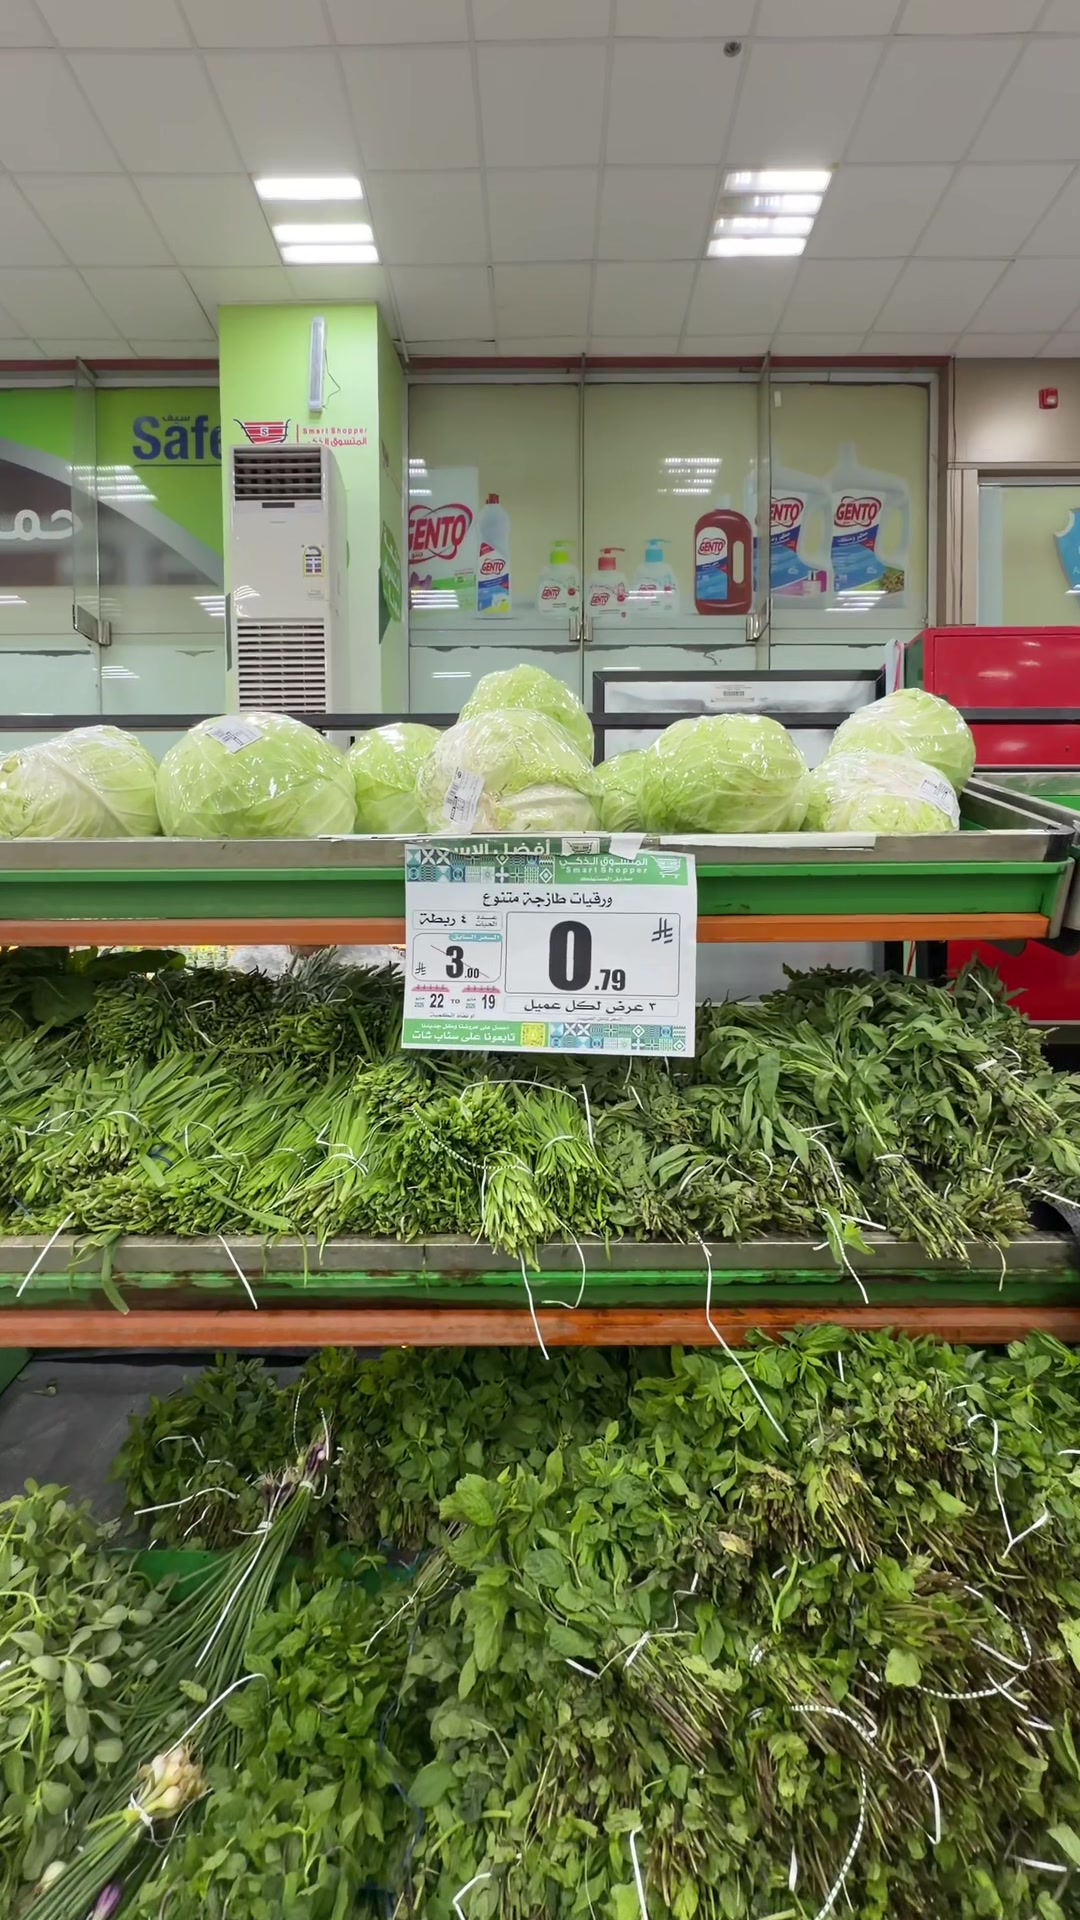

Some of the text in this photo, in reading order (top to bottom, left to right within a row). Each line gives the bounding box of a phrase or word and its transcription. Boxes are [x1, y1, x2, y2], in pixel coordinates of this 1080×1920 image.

[302, 426, 368, 436] Smart Shopper
[836, 503, 878, 521] GENTO
[700, 541, 724, 552] GENTO
[481, 562, 504, 572] GENTO
[559, 856, 598, 867] الذكي
[566, 866, 648, 875] Smart Shopper
[482, 891, 613, 907] ورقيات طازجة متنوع
[420, 913, 456, 927] ربطة
[430, 993, 444, 1008] 22
[481, 994, 496, 1010] 19
[524, 999, 656, 1014] ٣ عرض لكل عميل
[412, 1031, 516, 1043] تابعونا على سناب شات
